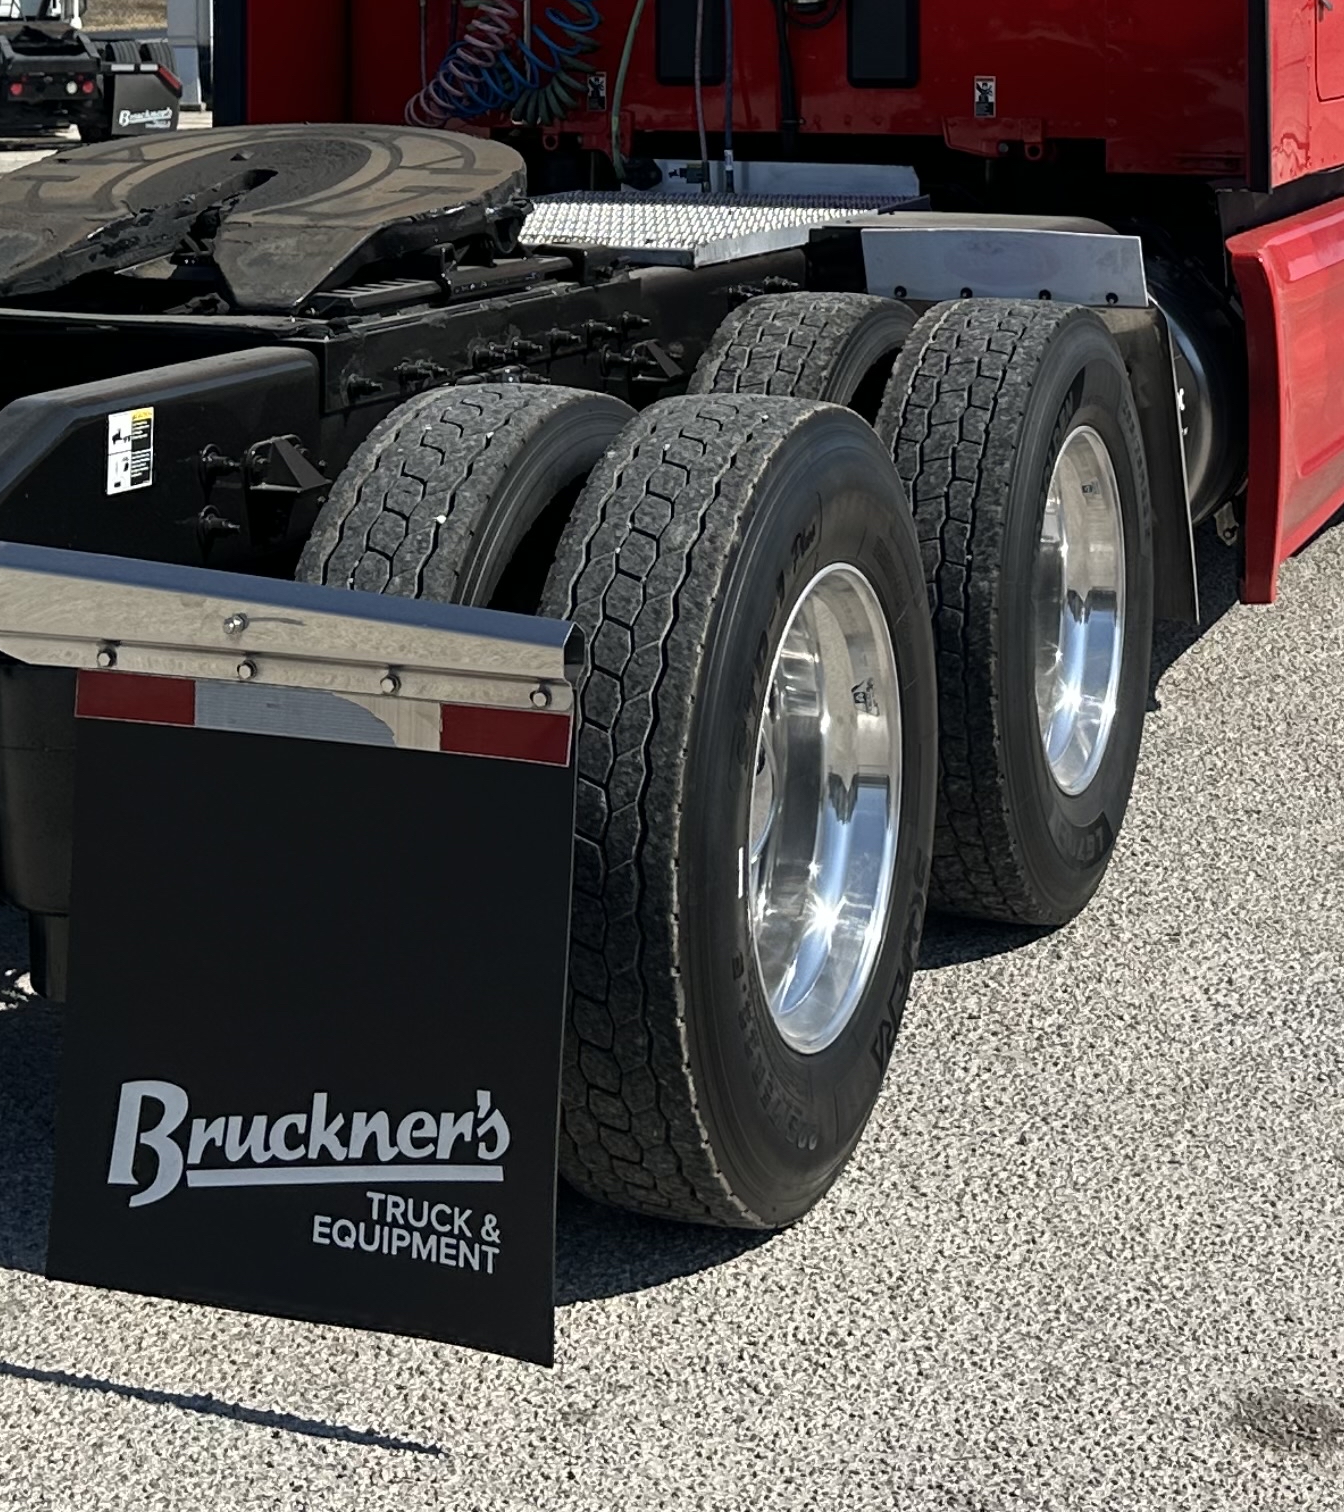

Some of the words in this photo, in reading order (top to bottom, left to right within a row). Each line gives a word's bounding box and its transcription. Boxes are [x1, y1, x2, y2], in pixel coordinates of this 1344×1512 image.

[107, 1079, 511, 1208] Bruckner's
[312, 1214, 501, 1275] EQUIPMENT
[366, 1191, 473, 1237] TRUCK
[481, 1214, 501, 1244] &
